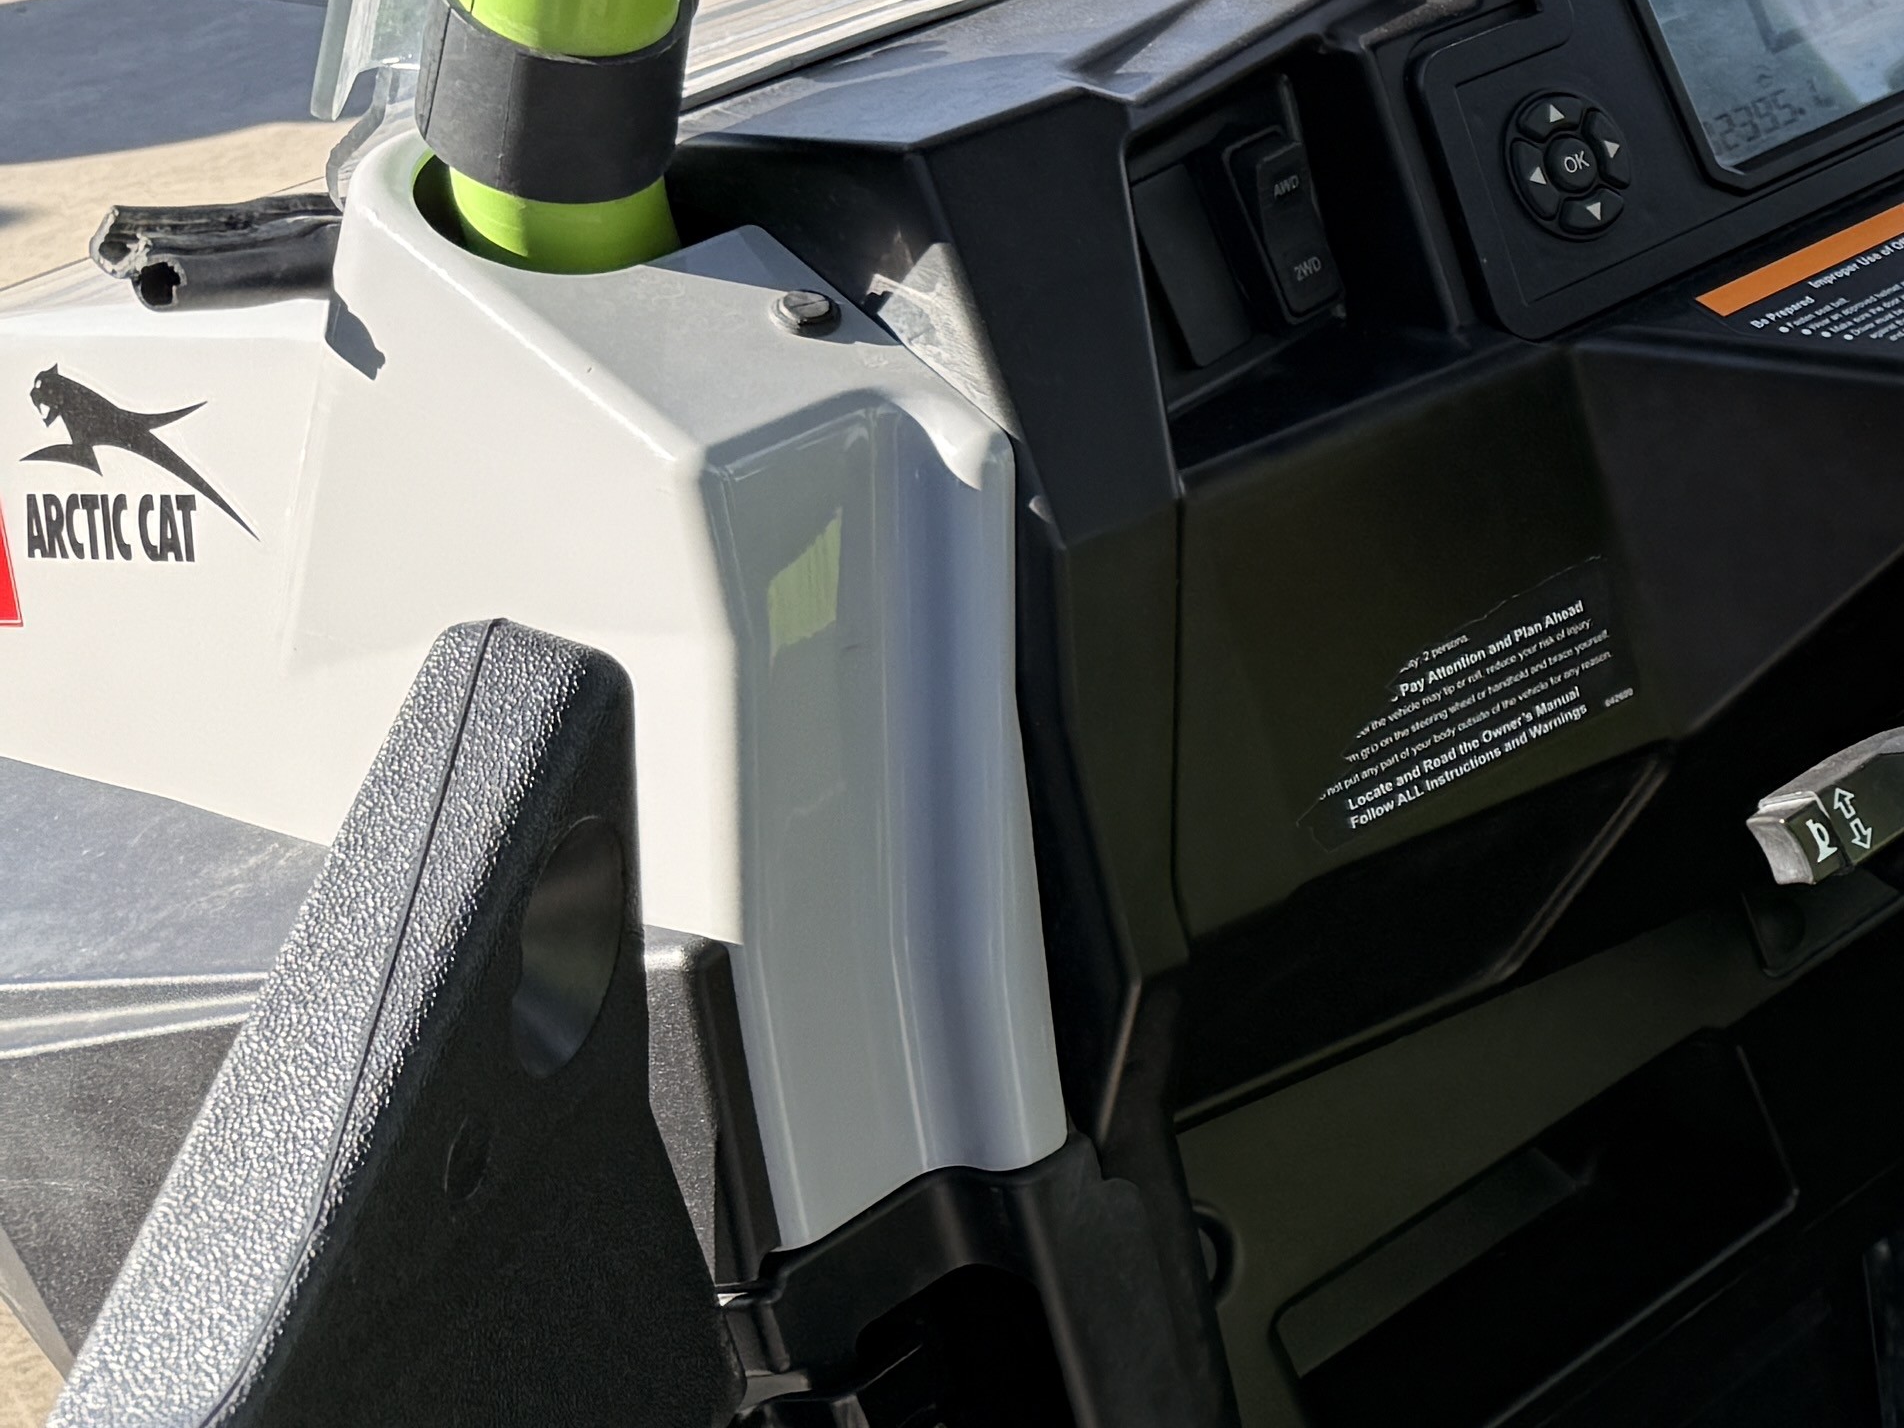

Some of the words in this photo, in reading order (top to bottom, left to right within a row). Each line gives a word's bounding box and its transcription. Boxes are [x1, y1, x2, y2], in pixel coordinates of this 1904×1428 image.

[1564, 150, 1590, 174] OK
[1273, 174, 1299, 200] AWD
[1294, 256, 1322, 282] 2WD
[1807, 263, 1859, 288] Improper
[1856, 253, 1882, 265] Use
[1880, 245, 1894, 255] of
[1749, 318, 1769, 328] Be
[1765, 295, 1814, 320] Prepared
[26, 492, 133, 561] ARCTIC
[138, 493, 197, 563] CAT
[1399, 677, 1424, 696] Pay
[1428, 649, 1485, 684] Attention
[1488, 633, 1512, 654] and
[1513, 622, 1542, 641] Plan
[1544, 599, 1583, 628] Ahead
[1347, 781, 1392, 810] Locate
[1396, 765, 1420, 786] and
[1422, 747, 1456, 772] Read
[1458, 739, 1479, 754] the
[1481, 712, 1533, 742] Owner's
[1534, 685, 1579, 717] Manual
[1349, 799, 1394, 828] Follow
[1397, 785, 1424, 806] ALL
[1425, 747, 1501, 790] Instructions
[1504, 731, 1527, 752] and
[1528, 704, 1587, 738] Warnings
